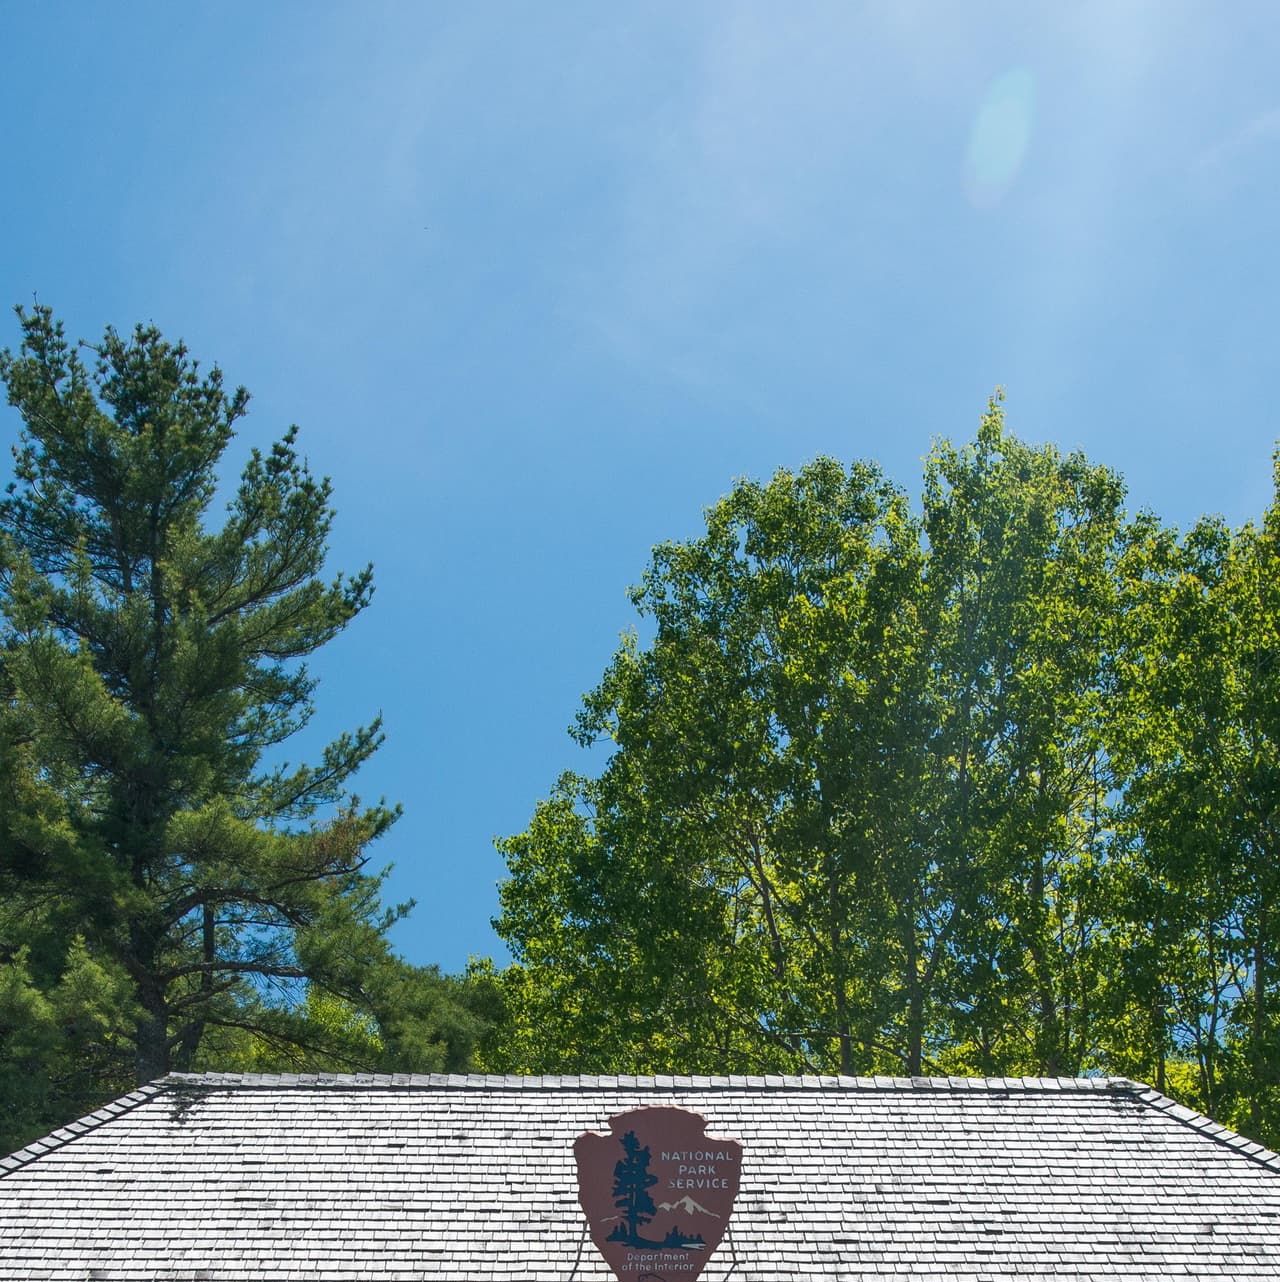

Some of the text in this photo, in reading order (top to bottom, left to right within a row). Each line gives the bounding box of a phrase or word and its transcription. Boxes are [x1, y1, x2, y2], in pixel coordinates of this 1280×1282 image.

[661, 1151, 733, 1161] NATIONAL
[679, 1165, 716, 1174] PARK
[668, 1178, 729, 1189] SERVICE
[627, 1253, 689, 1262] Department
[621, 1262, 695, 1271] of the Interior
